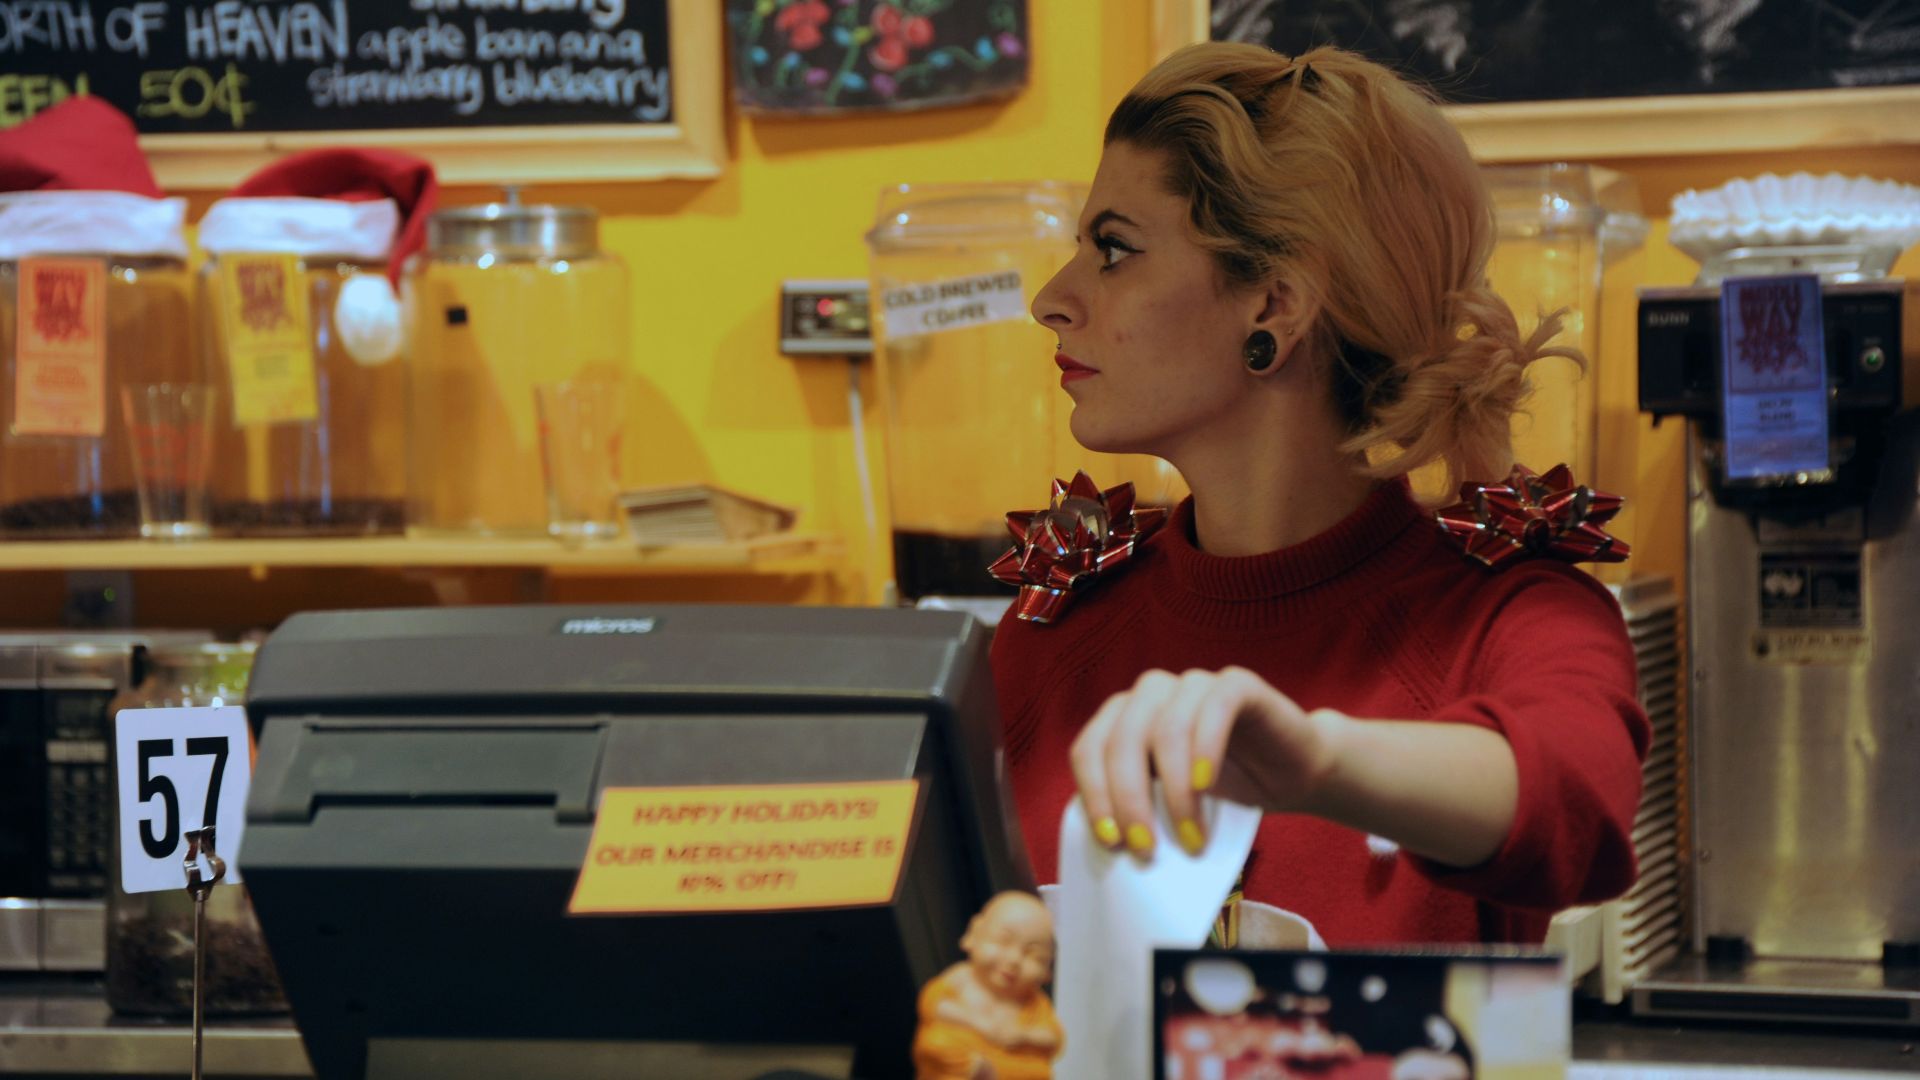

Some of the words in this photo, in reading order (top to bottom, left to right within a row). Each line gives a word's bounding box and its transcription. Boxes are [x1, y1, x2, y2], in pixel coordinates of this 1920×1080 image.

[105, 2, 172, 59] OF
[184, 0, 347, 62] HEAVEN
[357, 14, 466, 69] apple
[475, 16, 646, 65] banana
[138, 736, 228, 858] 57
[633, 802, 725, 826] HAPPY
[730, 798, 880, 823] HOLIDAYS!
[595, 844, 655, 866] OUR
[664, 839, 865, 866] MERCHANDISE
[872, 836, 896, 857] IS
